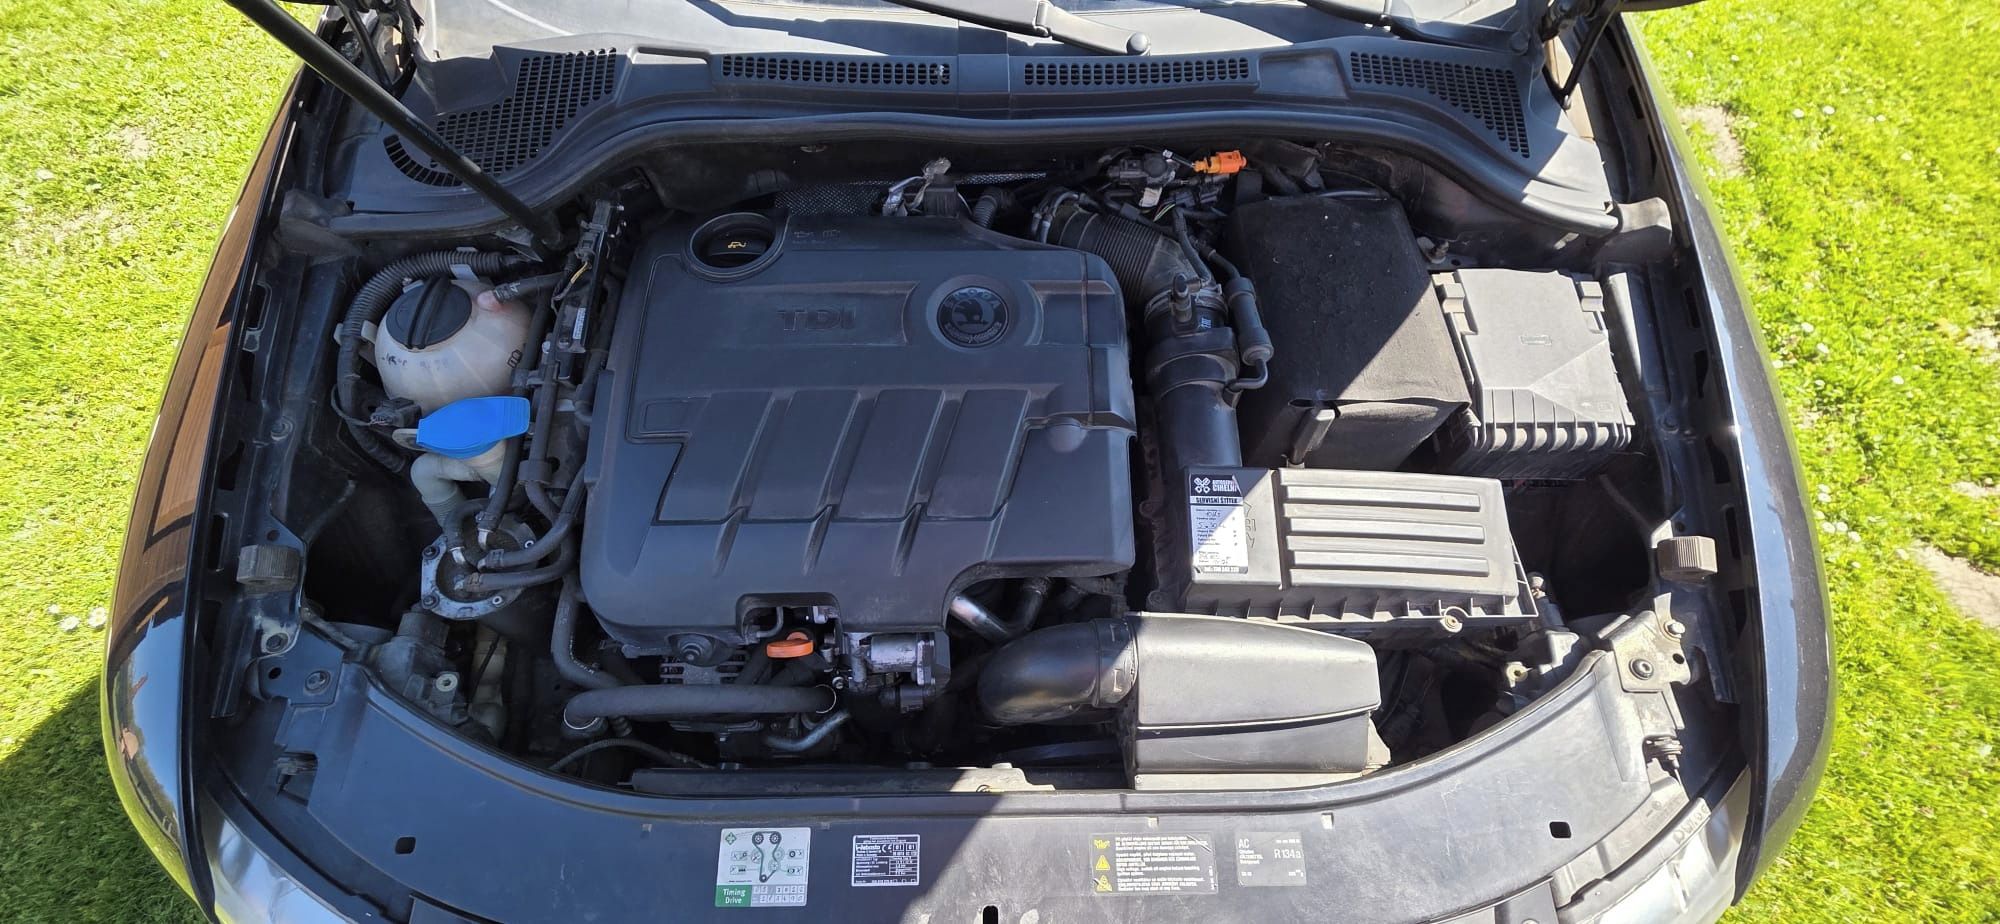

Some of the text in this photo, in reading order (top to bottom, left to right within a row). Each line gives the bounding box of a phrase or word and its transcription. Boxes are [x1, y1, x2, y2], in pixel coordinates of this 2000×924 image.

[776, 309, 857, 331] TDI
[1238, 838, 1250, 849] AC
[723, 888, 746, 898] Timing
[724, 896, 743, 905] Drive
